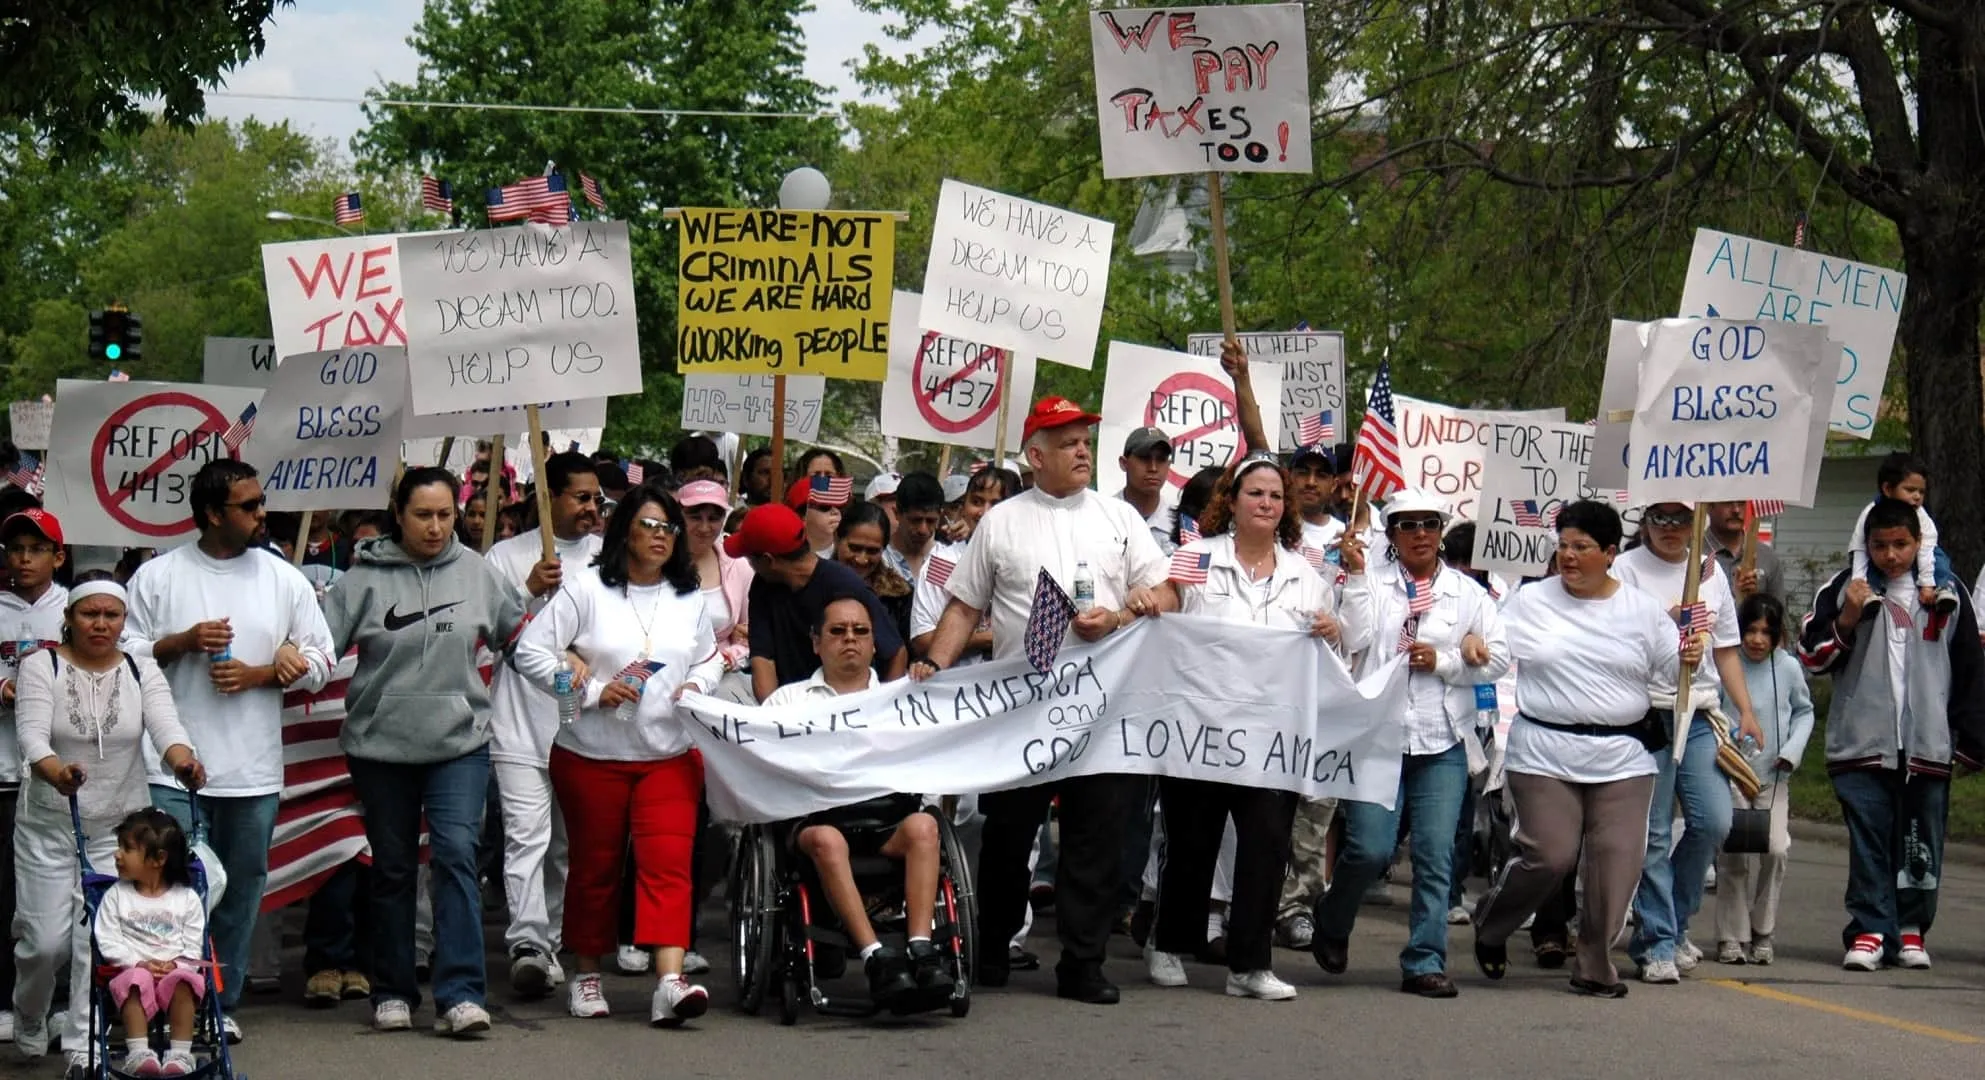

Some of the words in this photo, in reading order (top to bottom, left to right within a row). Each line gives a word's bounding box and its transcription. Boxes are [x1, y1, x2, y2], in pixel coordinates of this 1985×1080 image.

[1099, 11, 1212, 54] WE
[1192, 40, 1279, 95] PAY
[1110, 88, 1252, 139] TAXES
[963, 191, 997, 228] WE
[1005, 201, 1068, 244] HAVE
[1075, 223, 1099, 253] A
[434, 236, 490, 273] WE
[500, 229, 568, 270] HAVE
[579, 228, 609, 261] A
[950, 237, 1028, 285] DREAM
[1038, 258, 1089, 297] TOO
[287, 245, 393, 301] WE
[1706, 237, 1793, 292] ALL
[1816, 258, 1905, 314] MEN
[435, 288, 543, 335] DREAM
[685, 287, 737, 314] WE
[742, 284, 804, 312] ARE
[946, 287, 1011, 324] HELP
[1019, 303, 1067, 341] US
[448, 347, 530, 387] HELP
[551, 341, 604, 375] US
[1189, 338, 1217, 356] WE
[1270, 335, 1319, 356] HELP
[1692, 326, 1766, 361] GOD
[320, 352, 377, 385] GOD
[1281, 361, 1333, 383] INST
[925, 375, 995, 409] 4437
[1672, 384, 1777, 422] BLESS
[295, 403, 382, 440] BLESS
[1495, 423, 1548, 464] FOR
[1643, 440, 1770, 481] AMERICA
[118, 470, 198, 505] 443
[264, 456, 377, 490] AMERICA
[1421, 454, 1482, 494] POR
[1520, 465, 1558, 497] TO
[436, 622, 454, 632] NIKE
[691, 711, 755, 745] WE
[893, 690, 939, 727] IN
[954, 655, 1103, 721] AMERICA
[1047, 692, 1107, 726] and
[1121, 718, 1247, 768] LOVES
